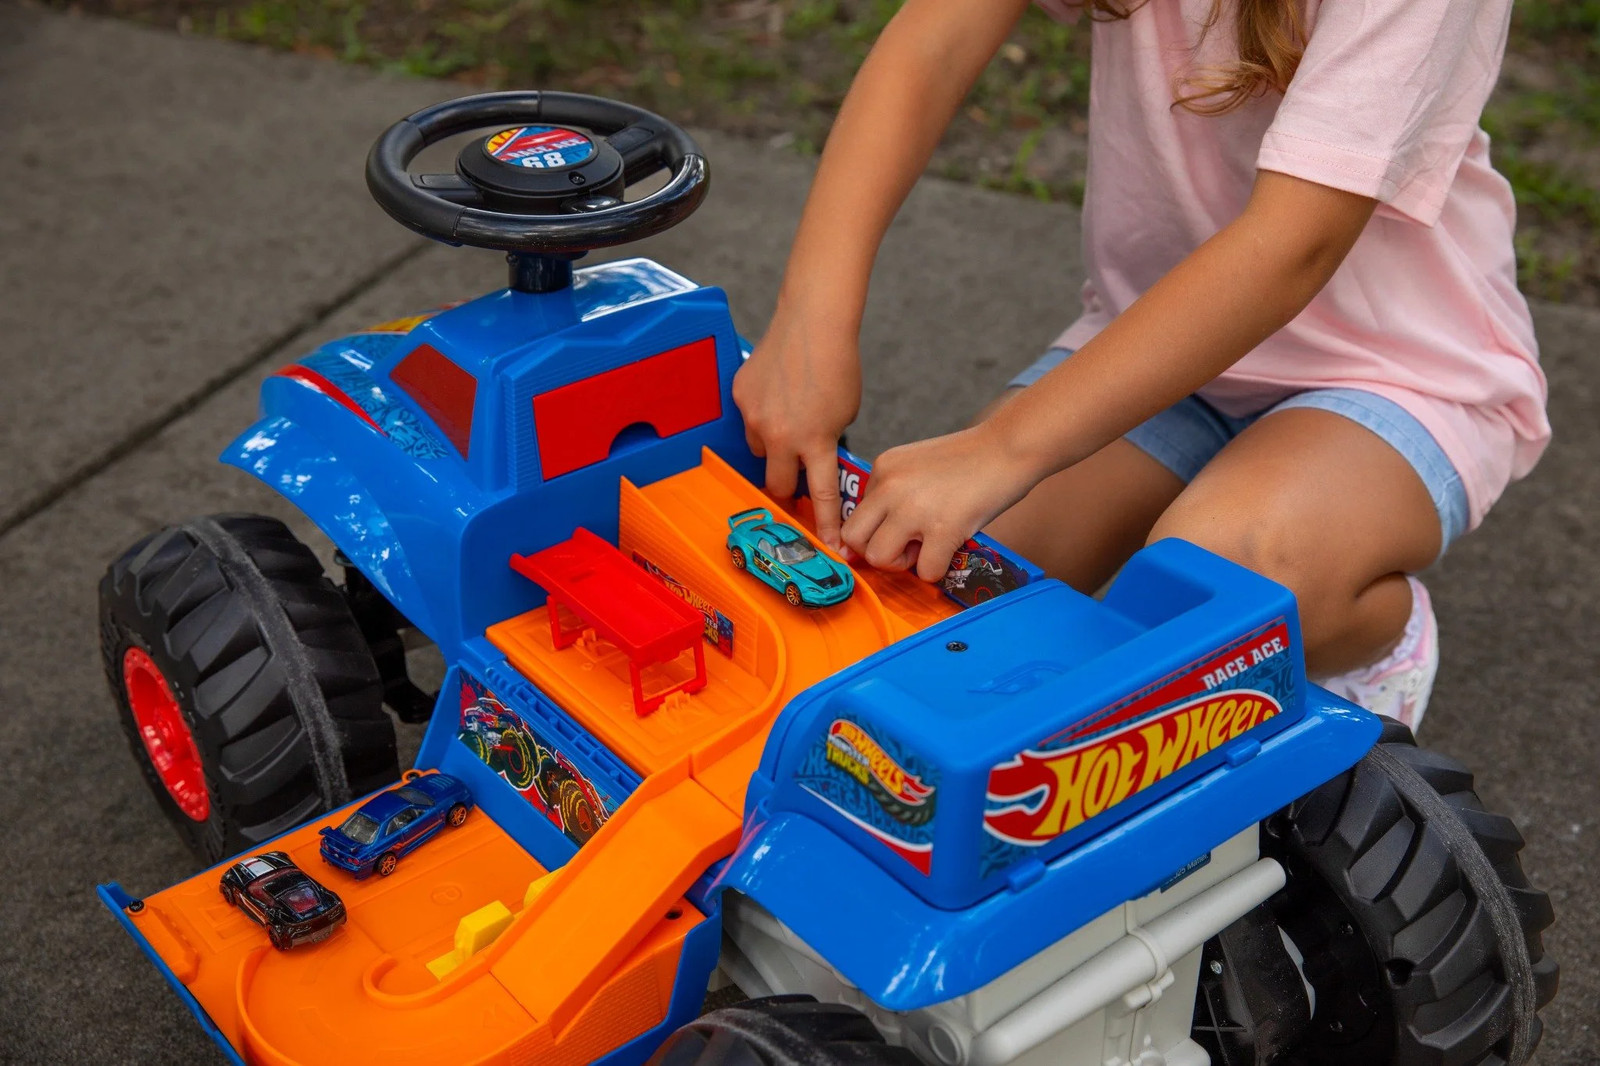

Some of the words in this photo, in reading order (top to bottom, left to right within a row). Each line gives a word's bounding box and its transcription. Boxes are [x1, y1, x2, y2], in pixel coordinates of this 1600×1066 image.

[521, 152, 566, 168] 68
[838, 469, 860, 498] IG
[1202, 654, 1249, 691] RACE
[1249, 636, 1284, 666] ACE
